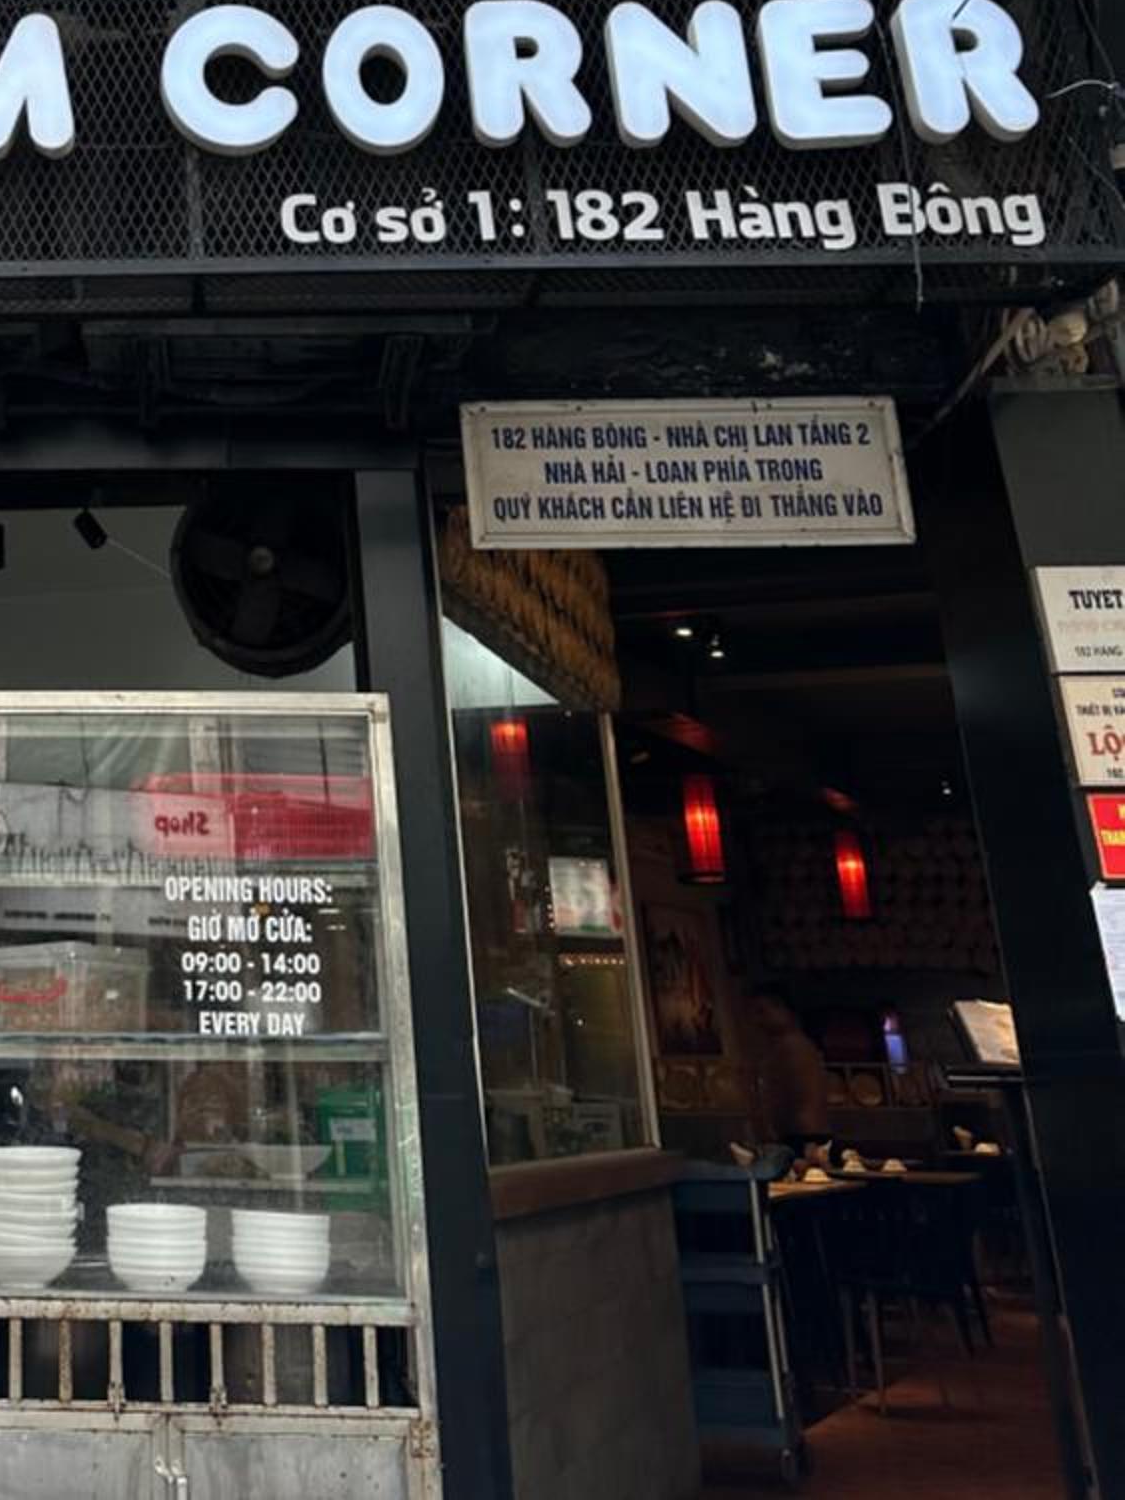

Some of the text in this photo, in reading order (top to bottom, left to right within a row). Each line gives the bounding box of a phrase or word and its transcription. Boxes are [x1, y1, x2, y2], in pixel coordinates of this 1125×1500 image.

[280, 192, 357, 244] Cơ
[375, 187, 448, 244] sở
[547, 189, 665, 241] 182
[685, 185, 857, 250] Hàng
[877, 183, 1046, 247] Bông
[491, 426, 526, 449] 182
[531, 423, 587, 449] HÀNG
[592, 423, 648, 449] BÔNG
[666, 421, 709, 448] NHÀ
[714, 425, 749, 452] CHỊ
[753, 424, 794, 446] LAN
[856, 423, 871, 445] 2
[544, 457, 588, 484] NHÀ
[592, 454, 626, 484] HẢI
[645, 461, 698, 484] LOAN
[703, 455, 752, 482] PHÍA
[755, 458, 823, 481] TRONG
[538, 493, 605, 520] KHÁCH
[658, 491, 704, 520] LIÊN
[709, 490, 735, 523] HỆ
[741, 495, 763, 518] ĐI
[842, 487, 884, 516] VÀO
[1086, 724, 1125, 761] LỘ
[165, 876, 333, 904] OPENING HOURS:
[181, 952, 242, 974] 09:00
[260, 953, 321, 975] 14:00
[183, 980, 242, 1002] 17:00
[260, 982, 322, 1003] 22:00
[199, 1011, 306, 1037] EVERY DAY
